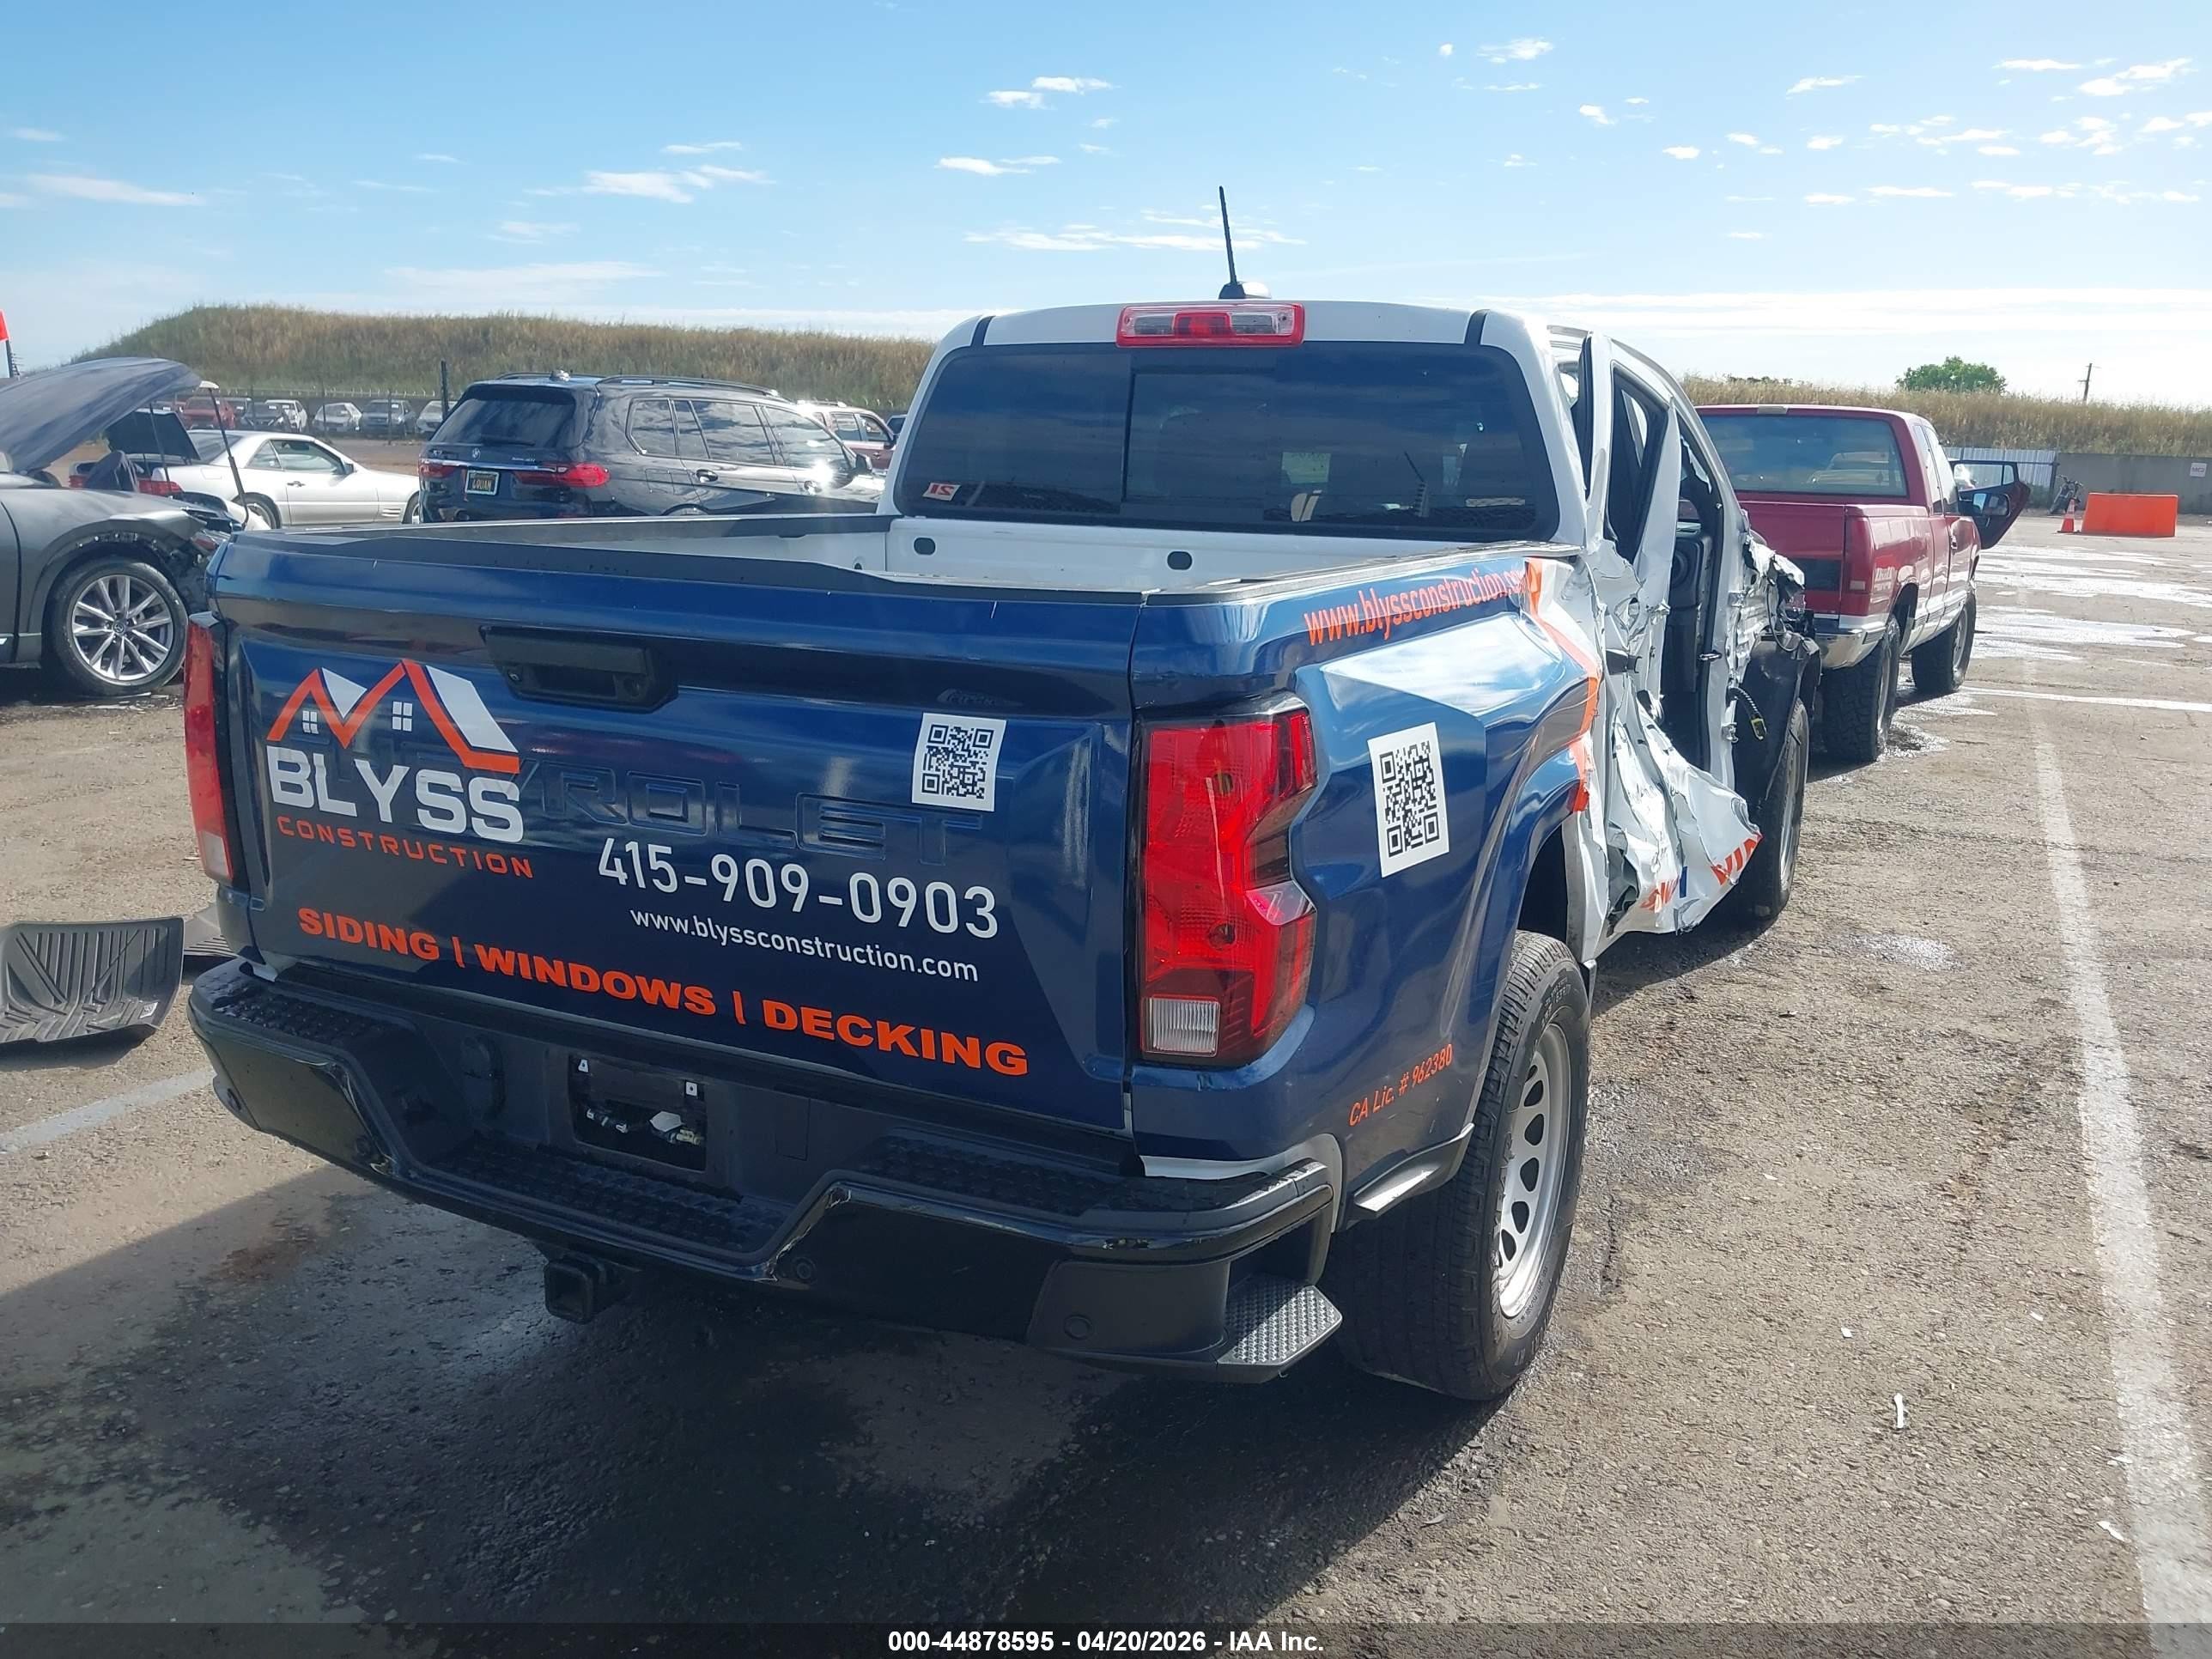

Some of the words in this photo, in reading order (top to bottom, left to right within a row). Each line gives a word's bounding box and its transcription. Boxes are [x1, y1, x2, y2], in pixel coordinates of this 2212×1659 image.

[266, 744, 524, 843] BLYSS
[276, 816, 533, 878] CONSTRUCTION
[599, 837, 998, 939] 415-909-0903
[629, 908, 979, 982] www.blyssconstruction.com
[298, 907, 440, 960] SIDING
[475, 944, 716, 1015] WINDOWS
[762, 999, 1029, 1076] DECKING
[1348, 1097, 1369, 1127] CA
[1398, 1071, 1409, 1096] #
[1411, 1043, 1453, 1089] 962380
